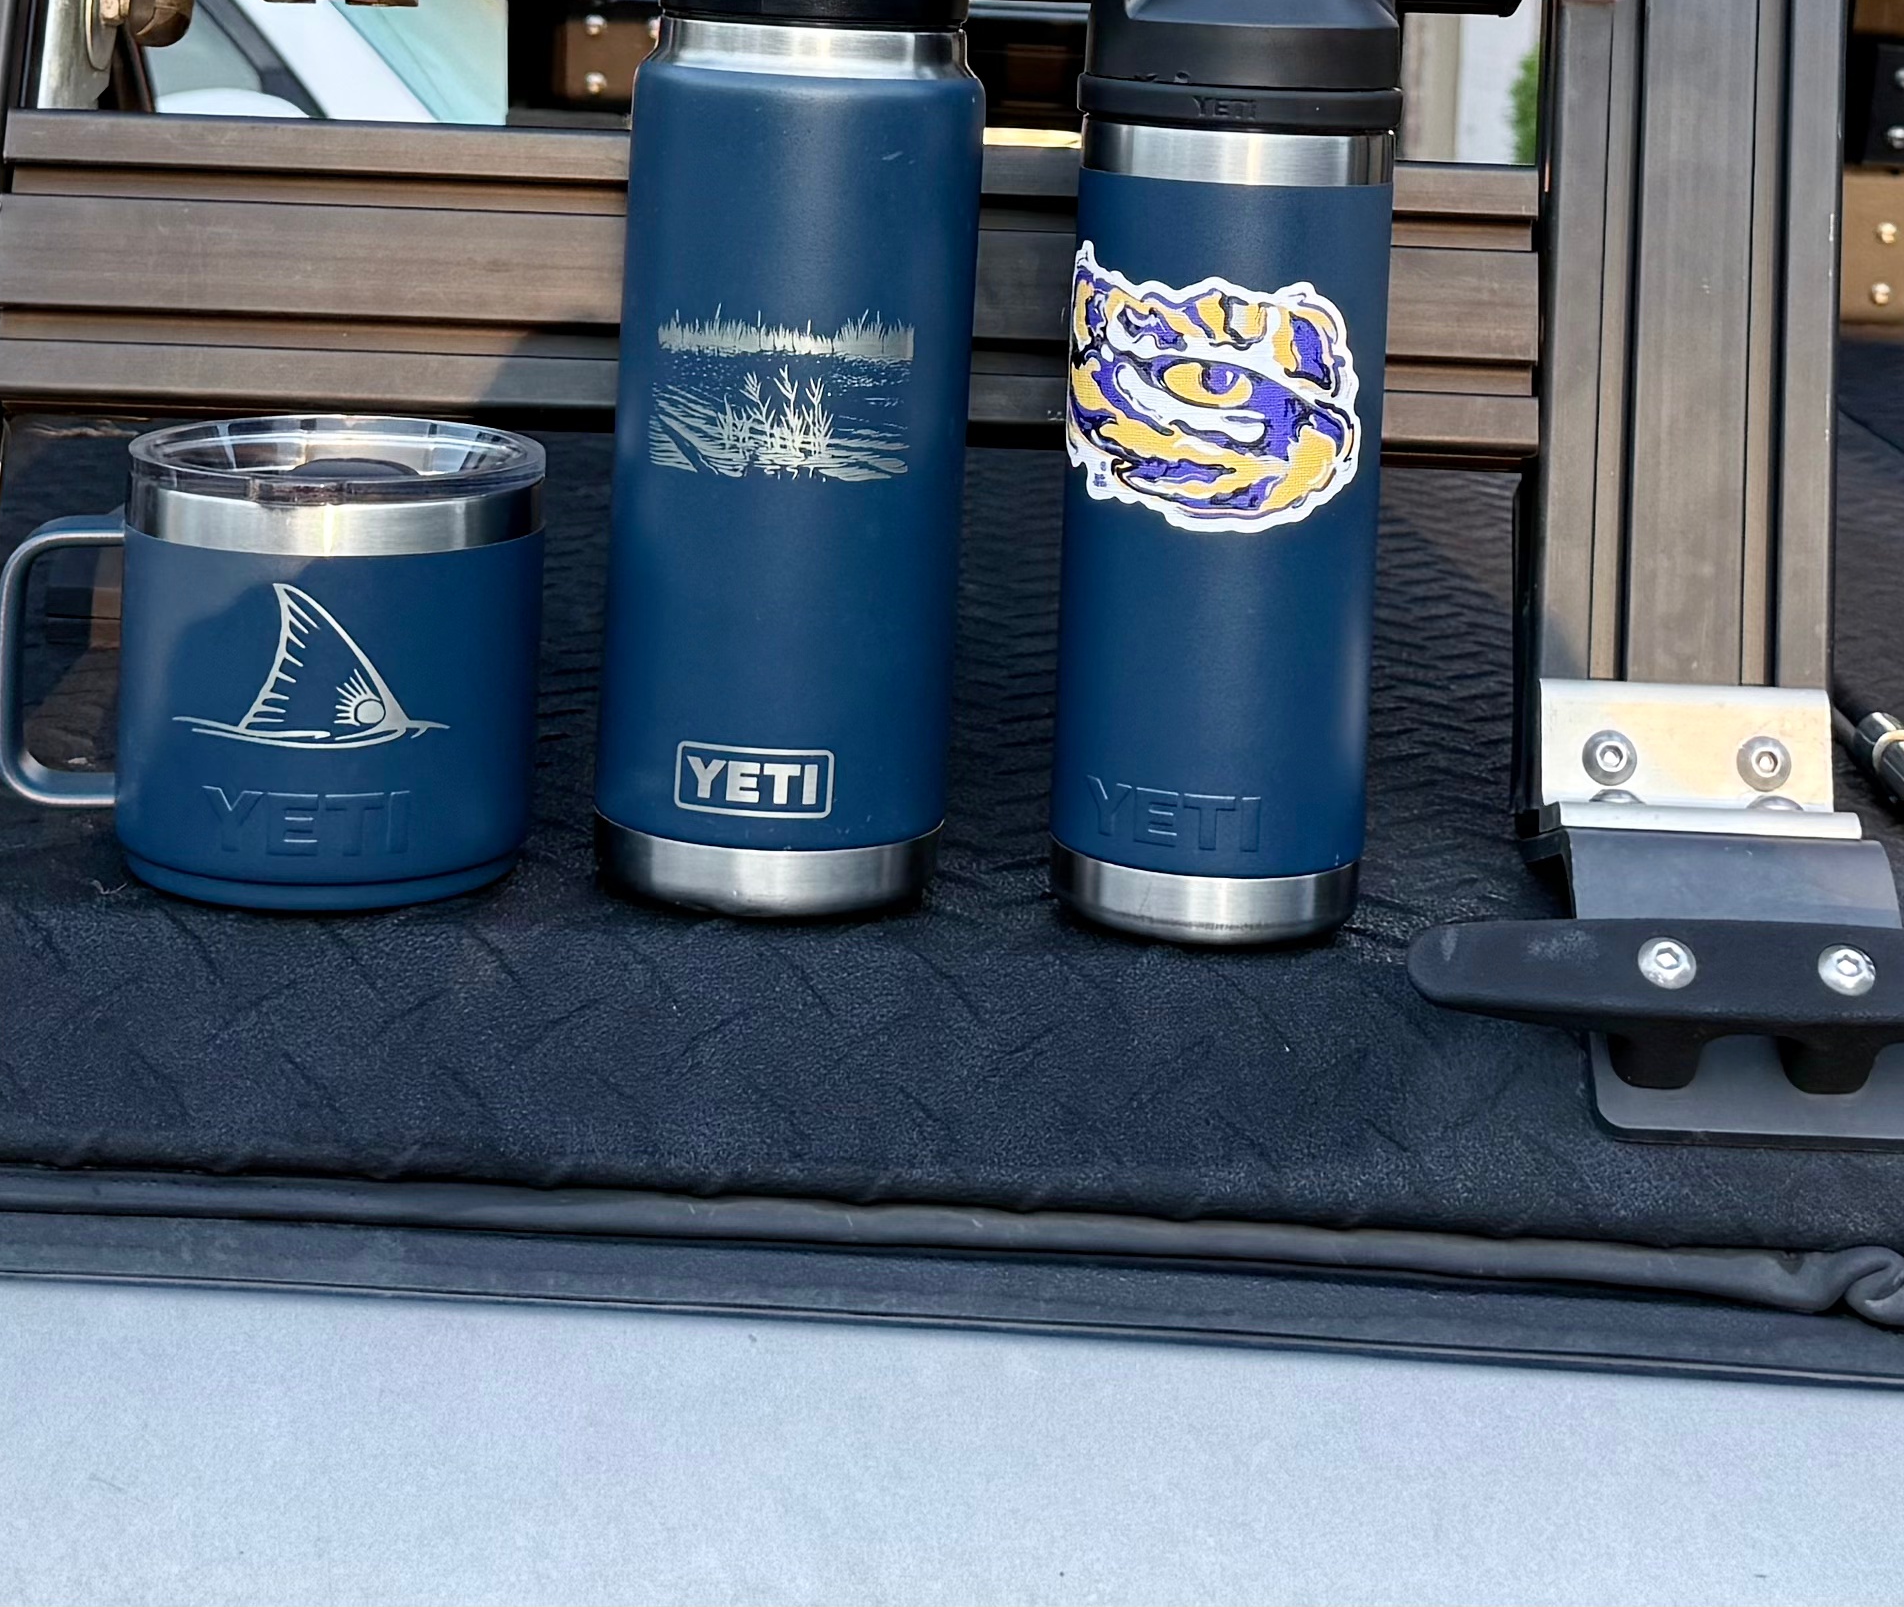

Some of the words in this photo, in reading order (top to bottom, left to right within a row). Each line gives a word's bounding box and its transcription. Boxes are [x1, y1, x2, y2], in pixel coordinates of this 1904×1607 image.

[1192, 95, 1257, 120] YETI
[686, 754, 820, 806] YETI
[202, 785, 411, 857] YETI
[1087, 774, 1262, 854] YETI
